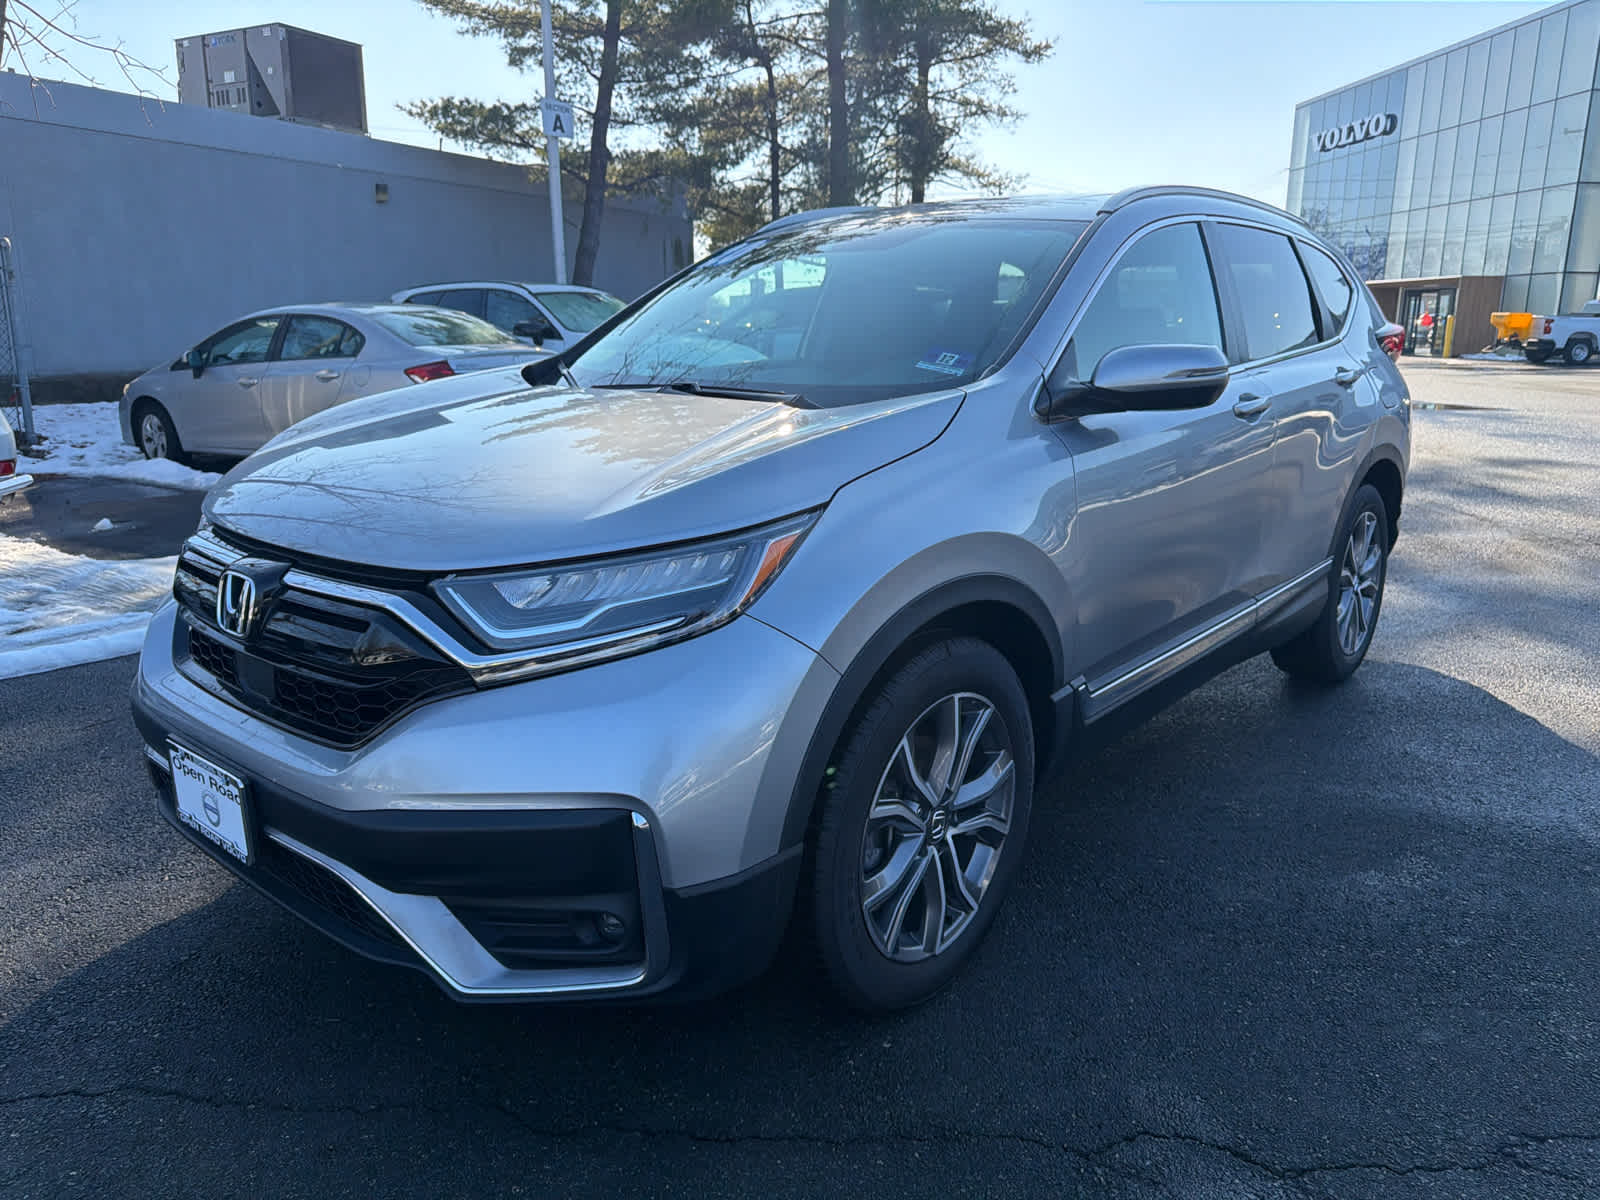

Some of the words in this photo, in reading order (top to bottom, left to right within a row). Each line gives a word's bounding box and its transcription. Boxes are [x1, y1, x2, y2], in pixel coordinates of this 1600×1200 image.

[552, 113, 565, 133] A
[1312, 112, 1397, 152] VOLVO
[172, 754, 206, 784] Open
